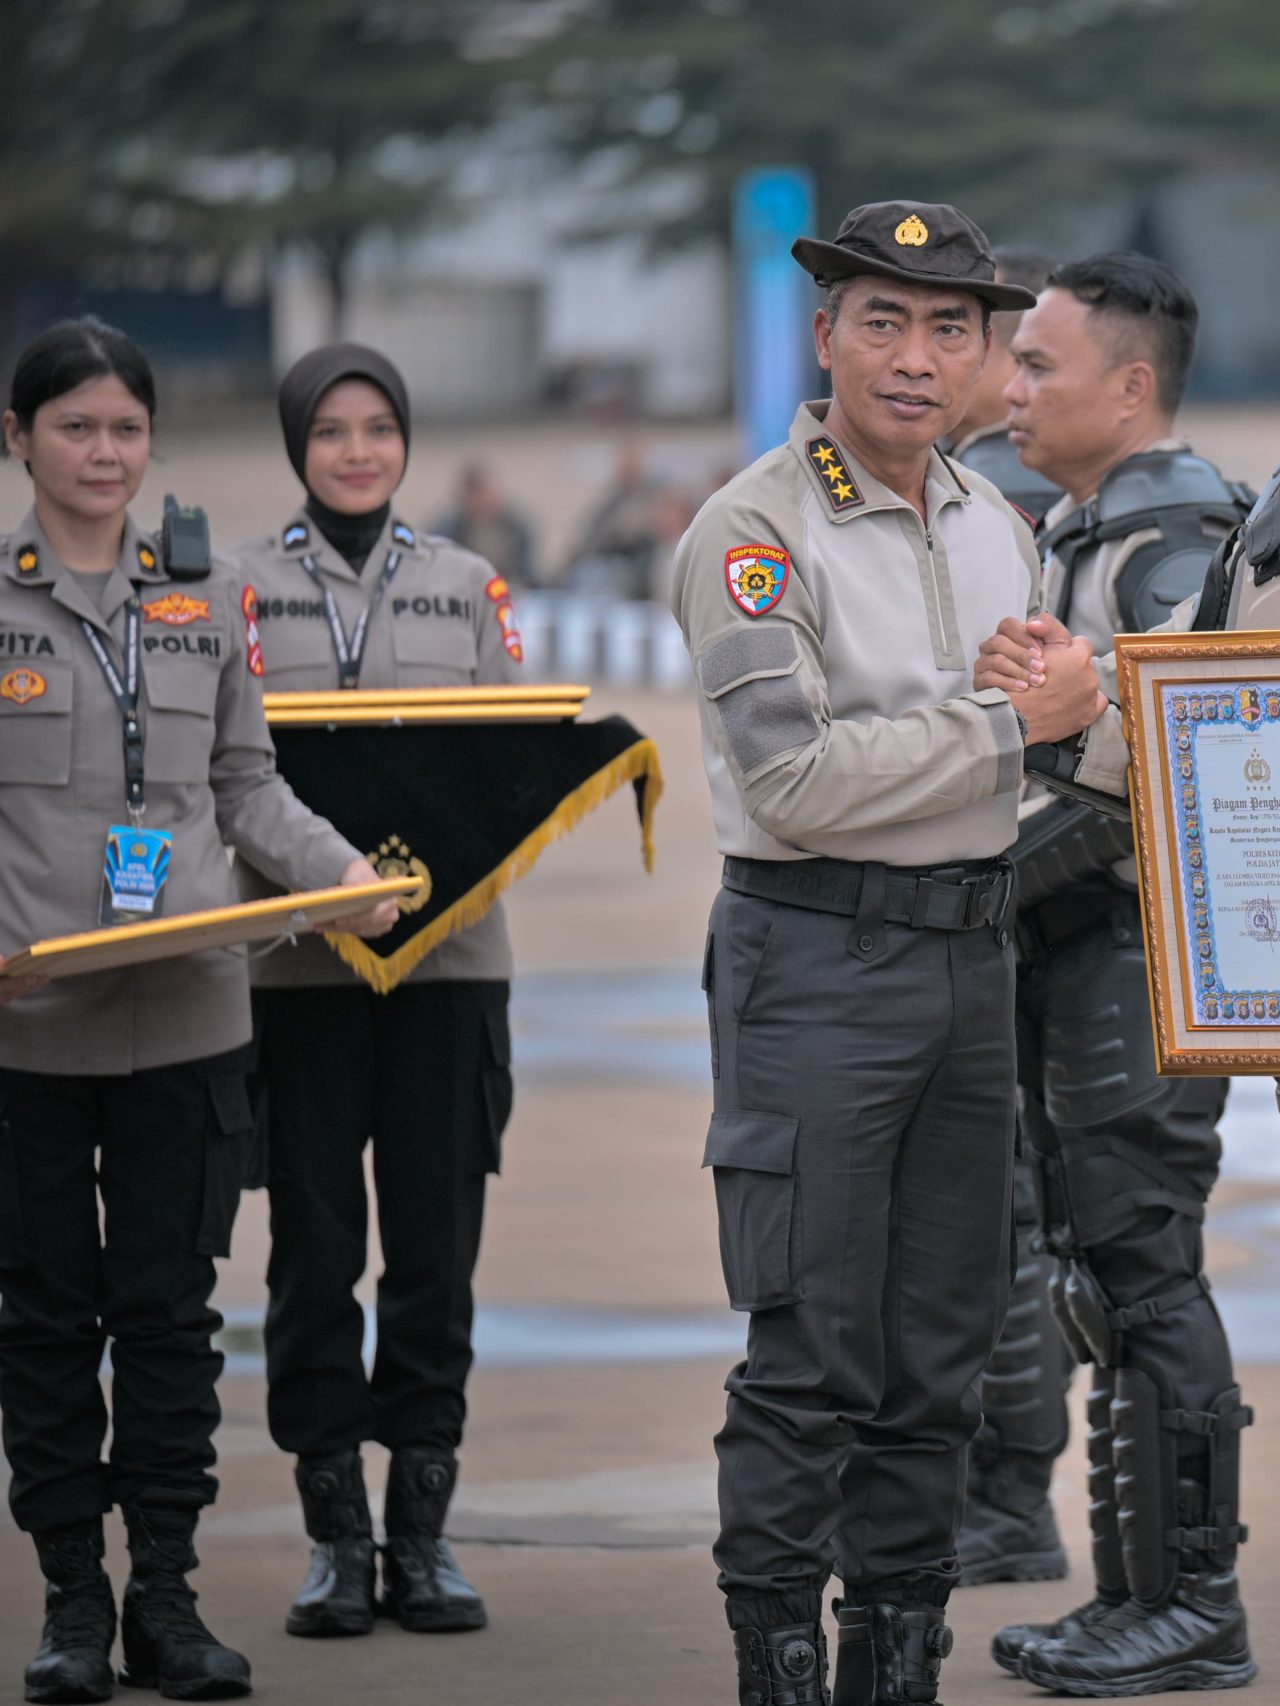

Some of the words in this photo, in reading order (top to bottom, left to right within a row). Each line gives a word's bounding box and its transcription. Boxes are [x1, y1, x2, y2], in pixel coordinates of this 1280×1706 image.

[729, 547, 785, 560] INSPEKTORAT
[392, 597, 470, 620] POLRI
[143, 634, 220, 658] POLRI
[1212, 798, 1247, 812] Piagam
[1243, 850, 1266, 858] POLRES
